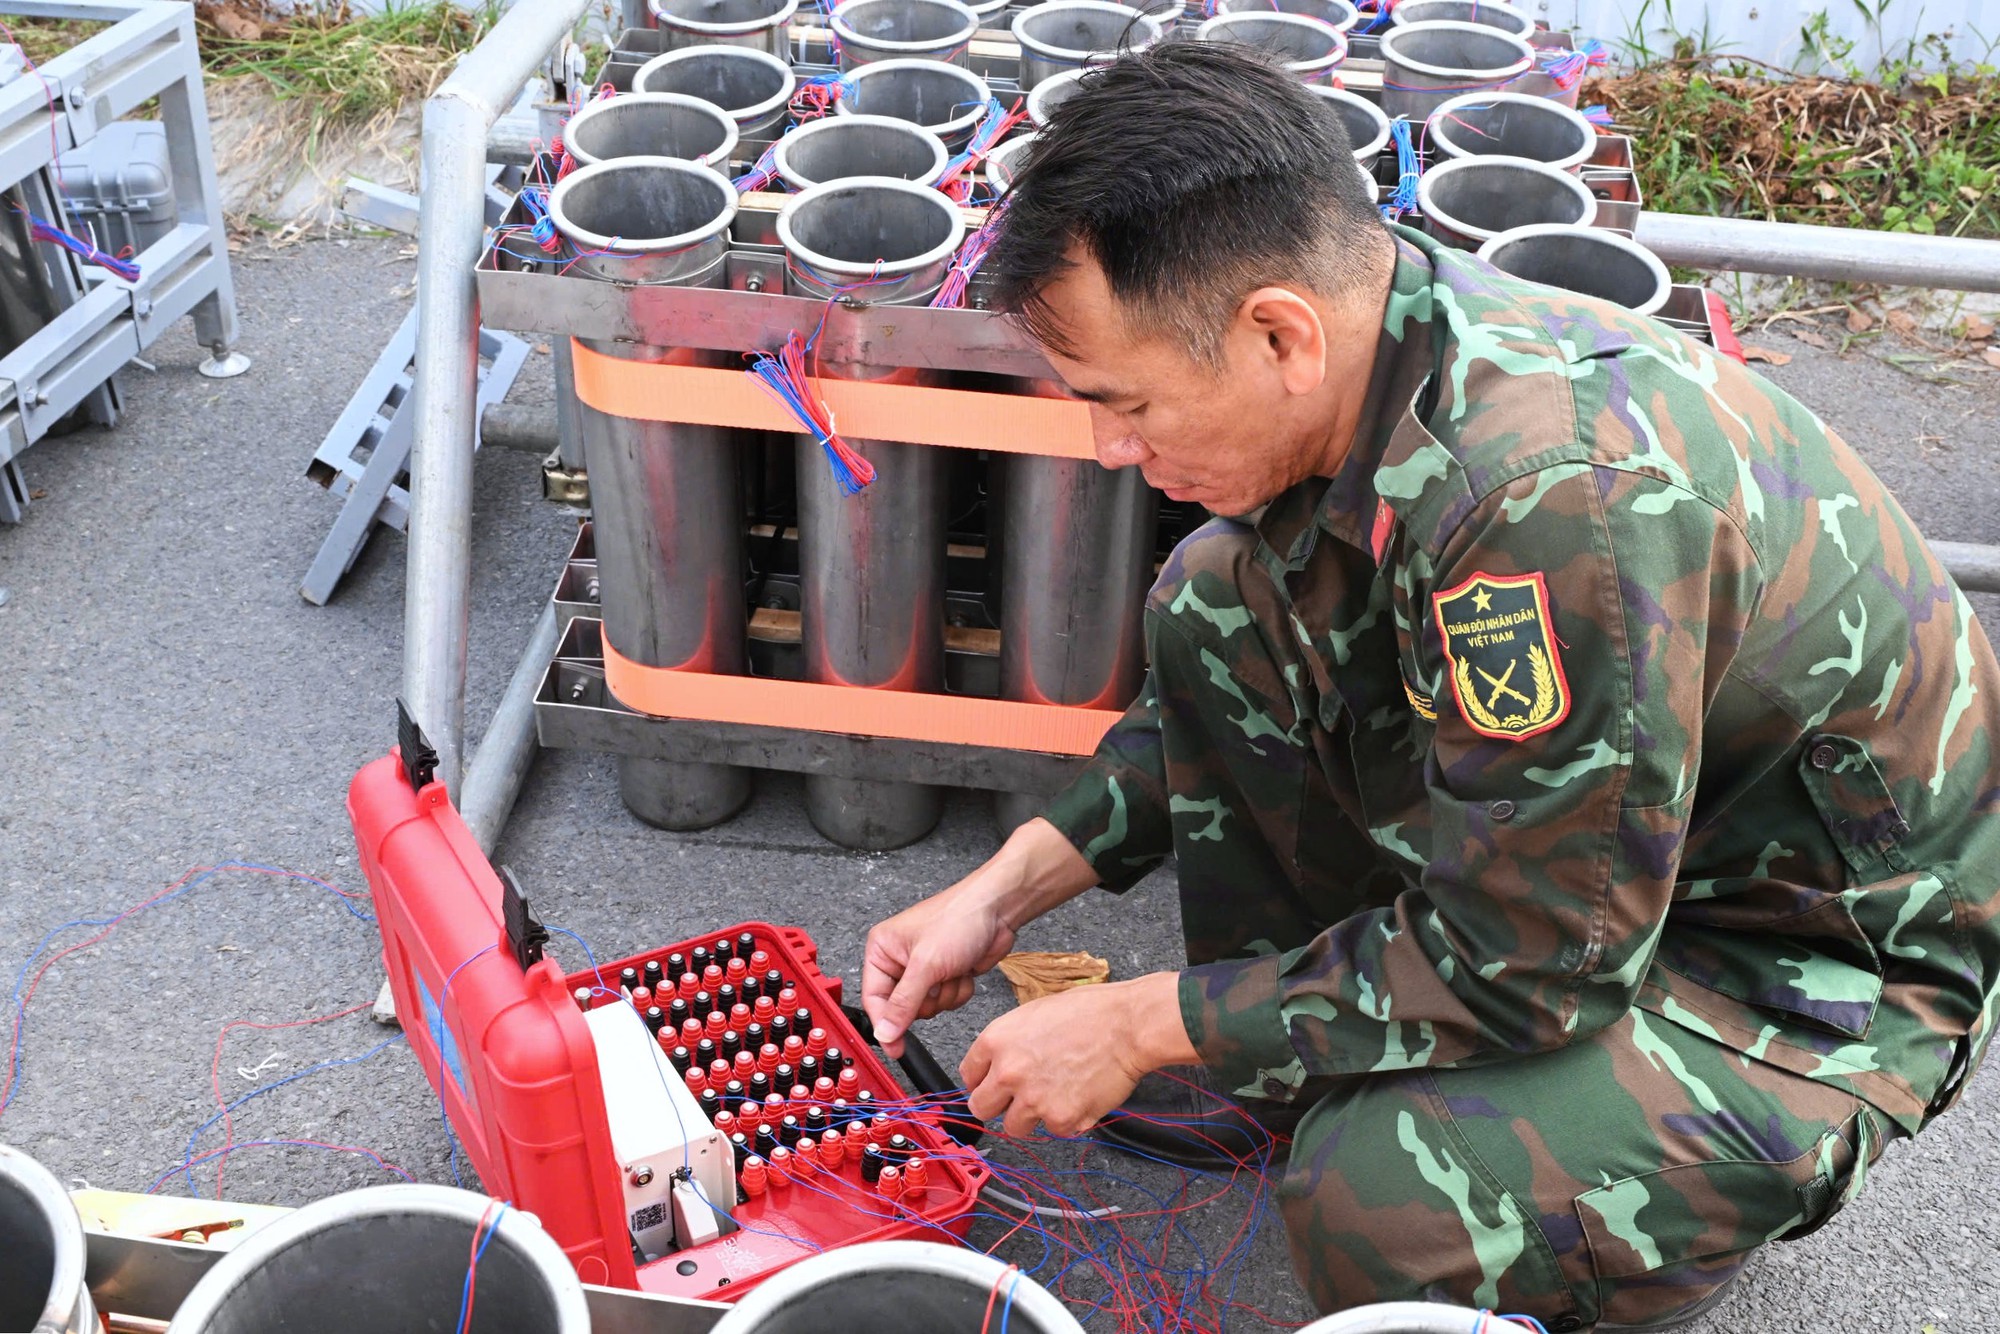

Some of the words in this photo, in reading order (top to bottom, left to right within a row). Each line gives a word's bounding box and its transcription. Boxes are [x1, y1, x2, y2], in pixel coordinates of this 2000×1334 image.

[1447, 622, 1470, 635] QUÂN
[1470, 618, 1486, 633] ĐỘI
[1486, 614, 1513, 630] NHÂN
[1513, 608, 1535, 624] DÂN
[1467, 633, 1489, 648] VIỆT
[1490, 630, 1514, 644] NAM
